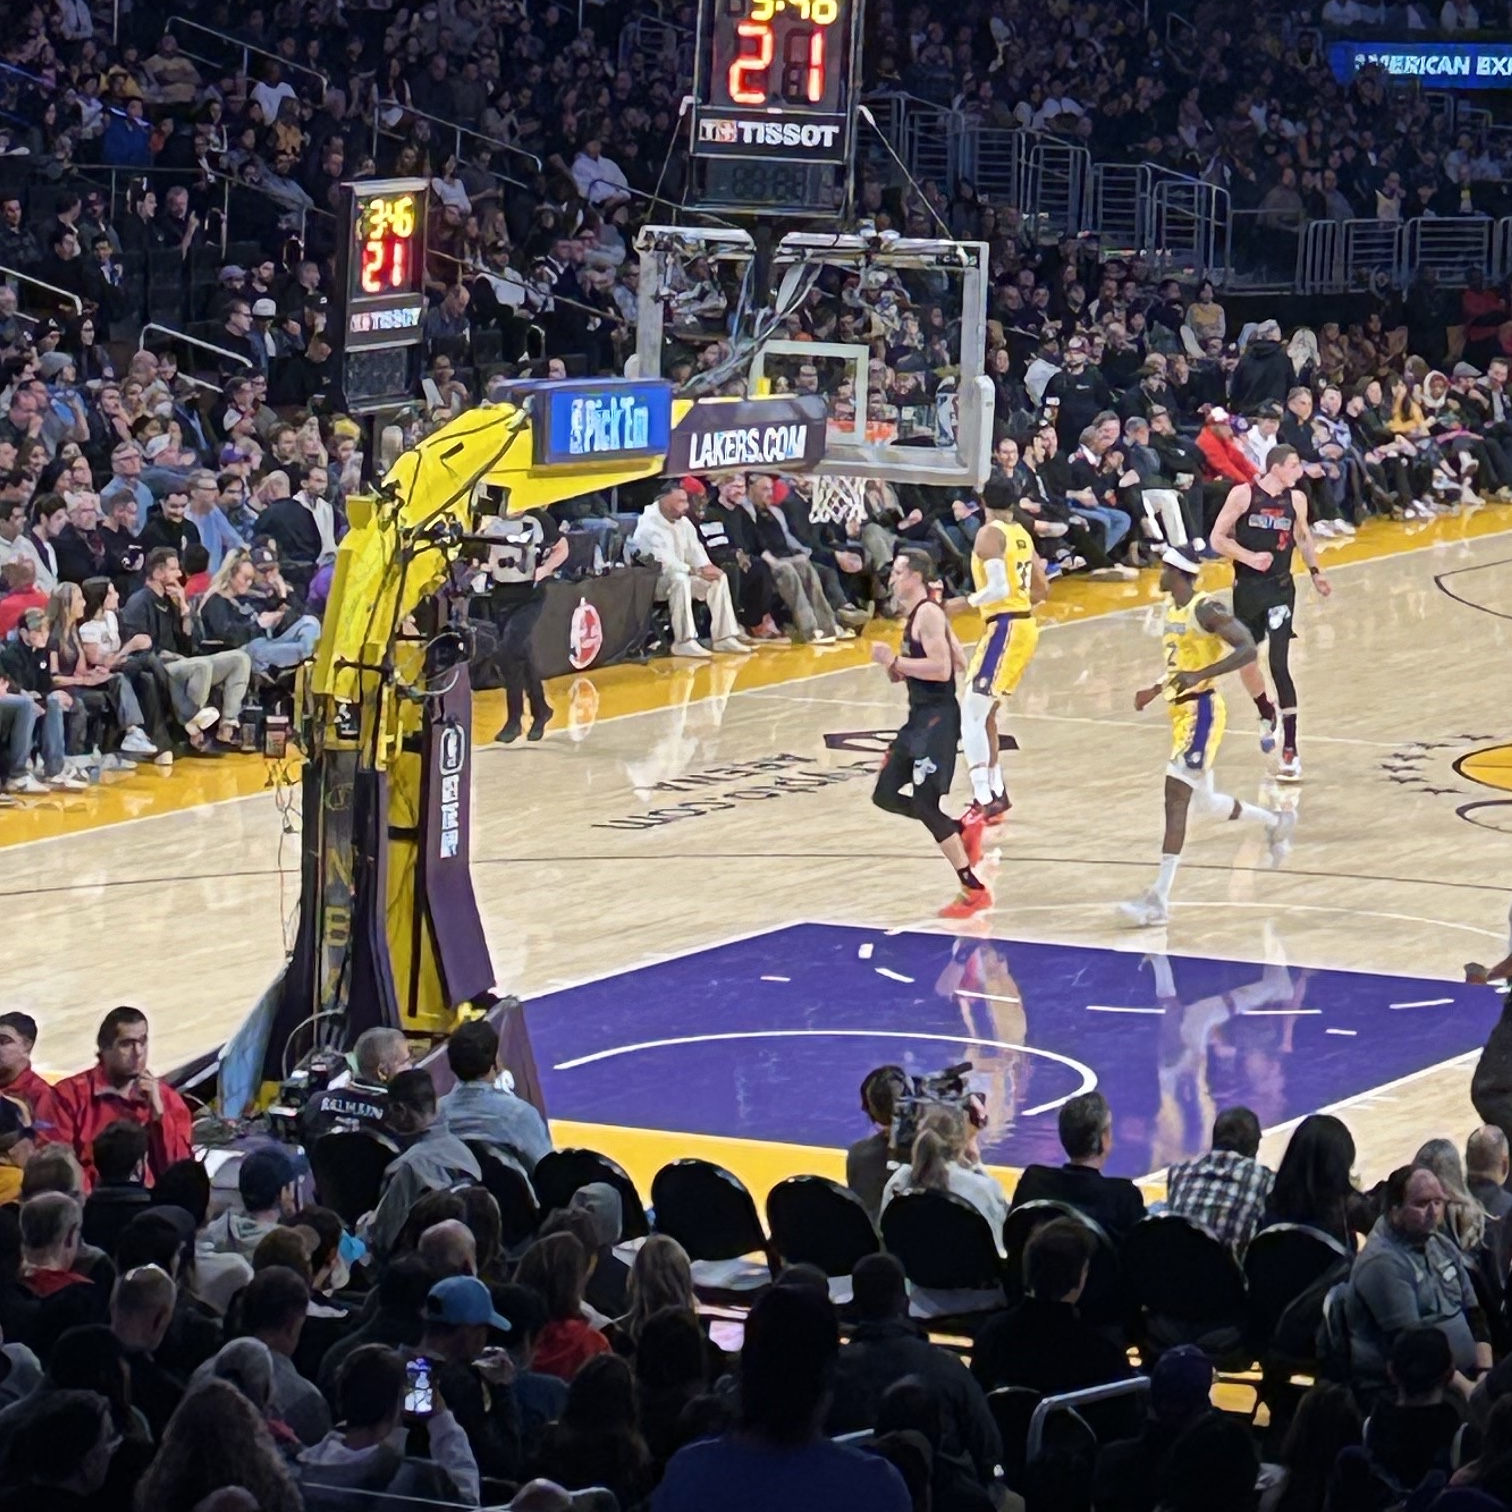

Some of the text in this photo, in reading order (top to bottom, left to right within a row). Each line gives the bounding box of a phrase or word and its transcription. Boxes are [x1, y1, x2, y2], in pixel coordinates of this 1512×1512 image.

[728, 24, 825, 104] 21
[1354, 54, 1470, 76] ERICAN
[738, 120, 839, 148] TISSOT
[362, 240, 403, 293] 21
[689, 424, 806, 469] LAKERS.COM
[1165, 640, 1178, 668] 2
